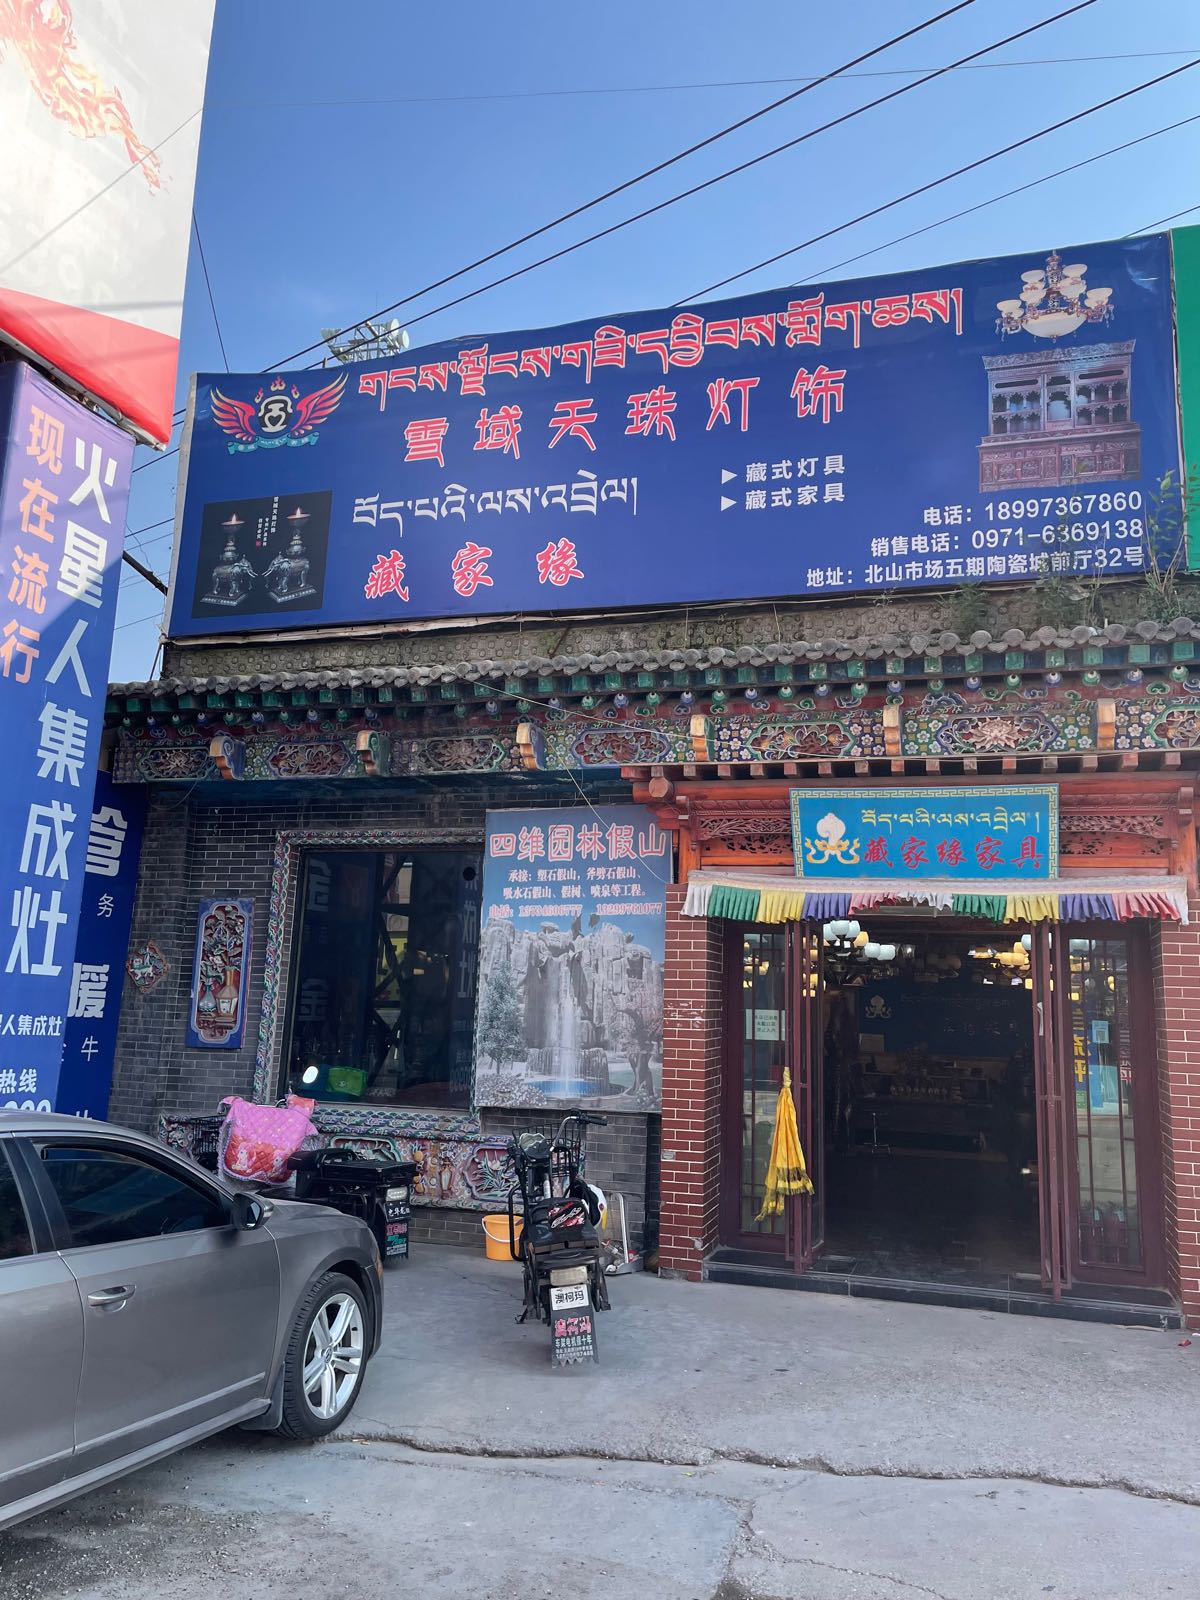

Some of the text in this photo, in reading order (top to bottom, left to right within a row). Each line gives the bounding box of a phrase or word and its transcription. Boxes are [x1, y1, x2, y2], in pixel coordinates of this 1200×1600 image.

[403, 364, 847, 468] 雪域天珠灯饰
[745, 454, 846, 485] 藏式灯具
[745, 482, 846, 511] 藏式家具
[0, 404, 66, 684] 现在流行
[364, 537, 585, 602] 藏家缘
[5, 437, 118, 976] 火星人集成灶
[489, 821, 667, 863] 四维园林假山
[864, 835, 1043, 870] 藏家缘家具
[0, 1013, 62, 1036] 人集成灶
